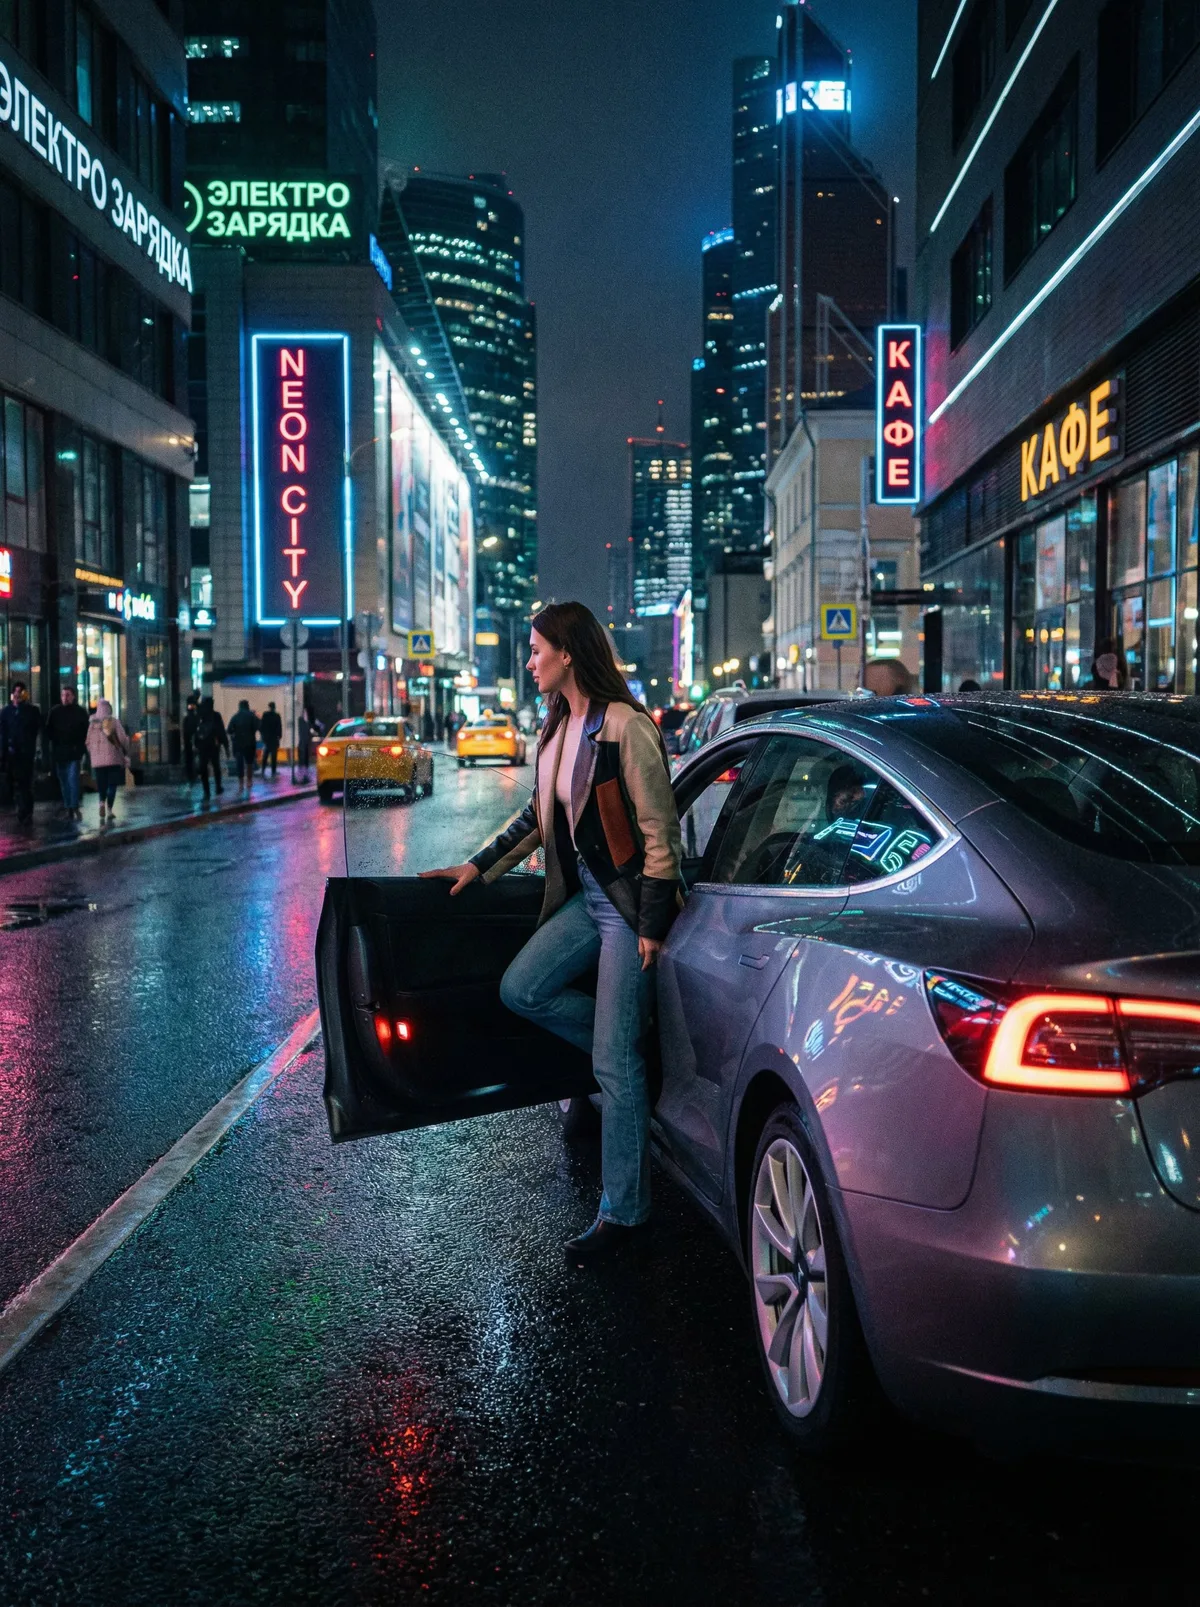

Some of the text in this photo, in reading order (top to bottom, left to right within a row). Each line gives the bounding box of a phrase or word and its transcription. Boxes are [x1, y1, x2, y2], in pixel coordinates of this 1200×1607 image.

[0, 61, 193, 293] ЭЛЕКТРО ЗАРЯДКА
[206, 211, 351, 242] ЗАРЯДКА
[207, 180, 350, 208] ЭЛЕКТРО
[279, 348, 308, 609] NEON CITY
[883, 340, 914, 486] КАФЕ
[1021, 380, 1112, 502] КАФЕ
